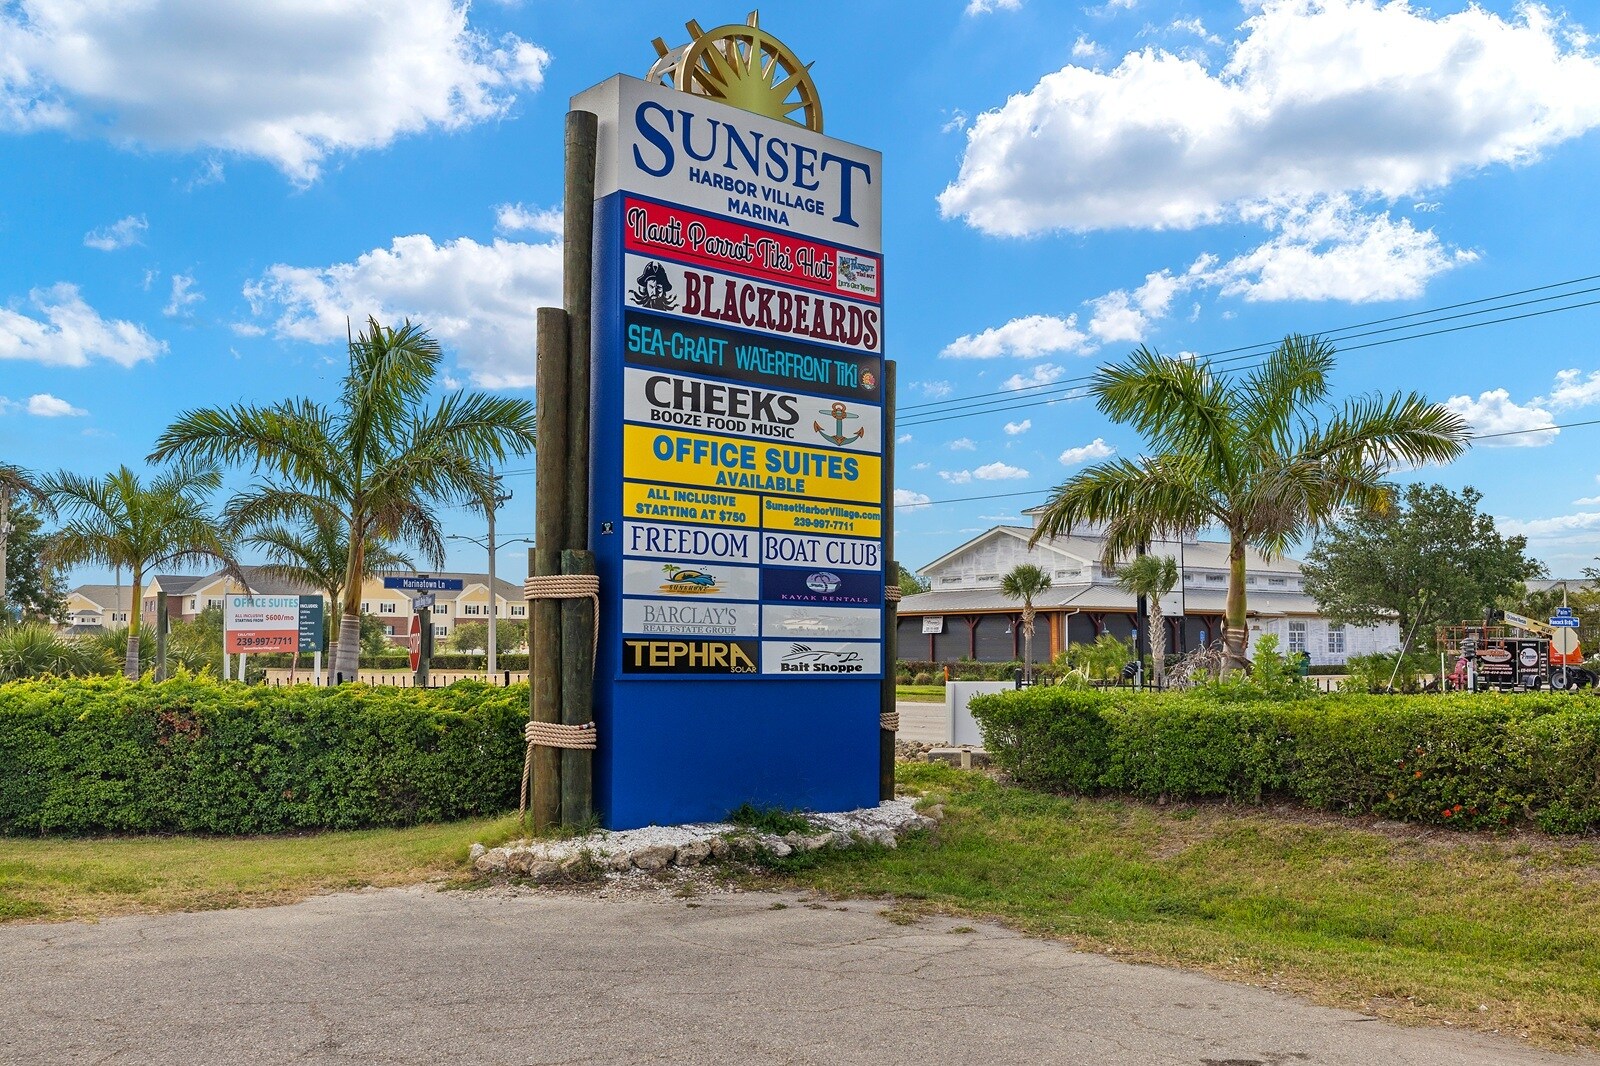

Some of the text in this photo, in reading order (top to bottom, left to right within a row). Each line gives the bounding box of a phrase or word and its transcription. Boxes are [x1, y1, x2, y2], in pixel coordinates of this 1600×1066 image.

[632, 100, 872, 228] SUNSET
[689, 166, 825, 216] HARBOR VILLAGE
[728, 197, 790, 226] MARINA
[627, 207, 835, 281] Nauti Parrot Tiki Hut
[682, 271, 878, 350] BLACKBEARDS
[628, 324, 728, 366] SEA-CRAFT
[734, 345, 832, 384] WATERFRONT
[644, 375, 800, 426] CHEEKS
[650, 408, 795, 439] BOOZE FOOD MUSIC
[652, 434, 860, 482] OFFICE SUITES
[715, 470, 805, 493] AVAILABLE
[647, 488, 736, 507] ALL INCLUSIVE
[635, 502, 746, 524] STARTING AT $750
[765, 500, 881, 521] SunsetHarborVillage.com
[793, 516, 855, 532] 239-997-7711
[631, 525, 749, 558] FREEDOM
[765, 535, 821, 562] BOAT
[403, 579, 446, 589] Marinatown Ln
[233, 597, 299, 608] OFFICE SUITES
[822, 595, 869, 603] RENTALS
[643, 604, 737, 626] BARCLAY'S
[643, 624, 736, 635] REAL ESTATE GROUP
[236, 636, 292, 646] 239-997-7711
[625, 640, 756, 668] TEPHRA
[730, 665, 757, 674] SOLAR
[780, 662, 863, 674] Bait Shoppe
